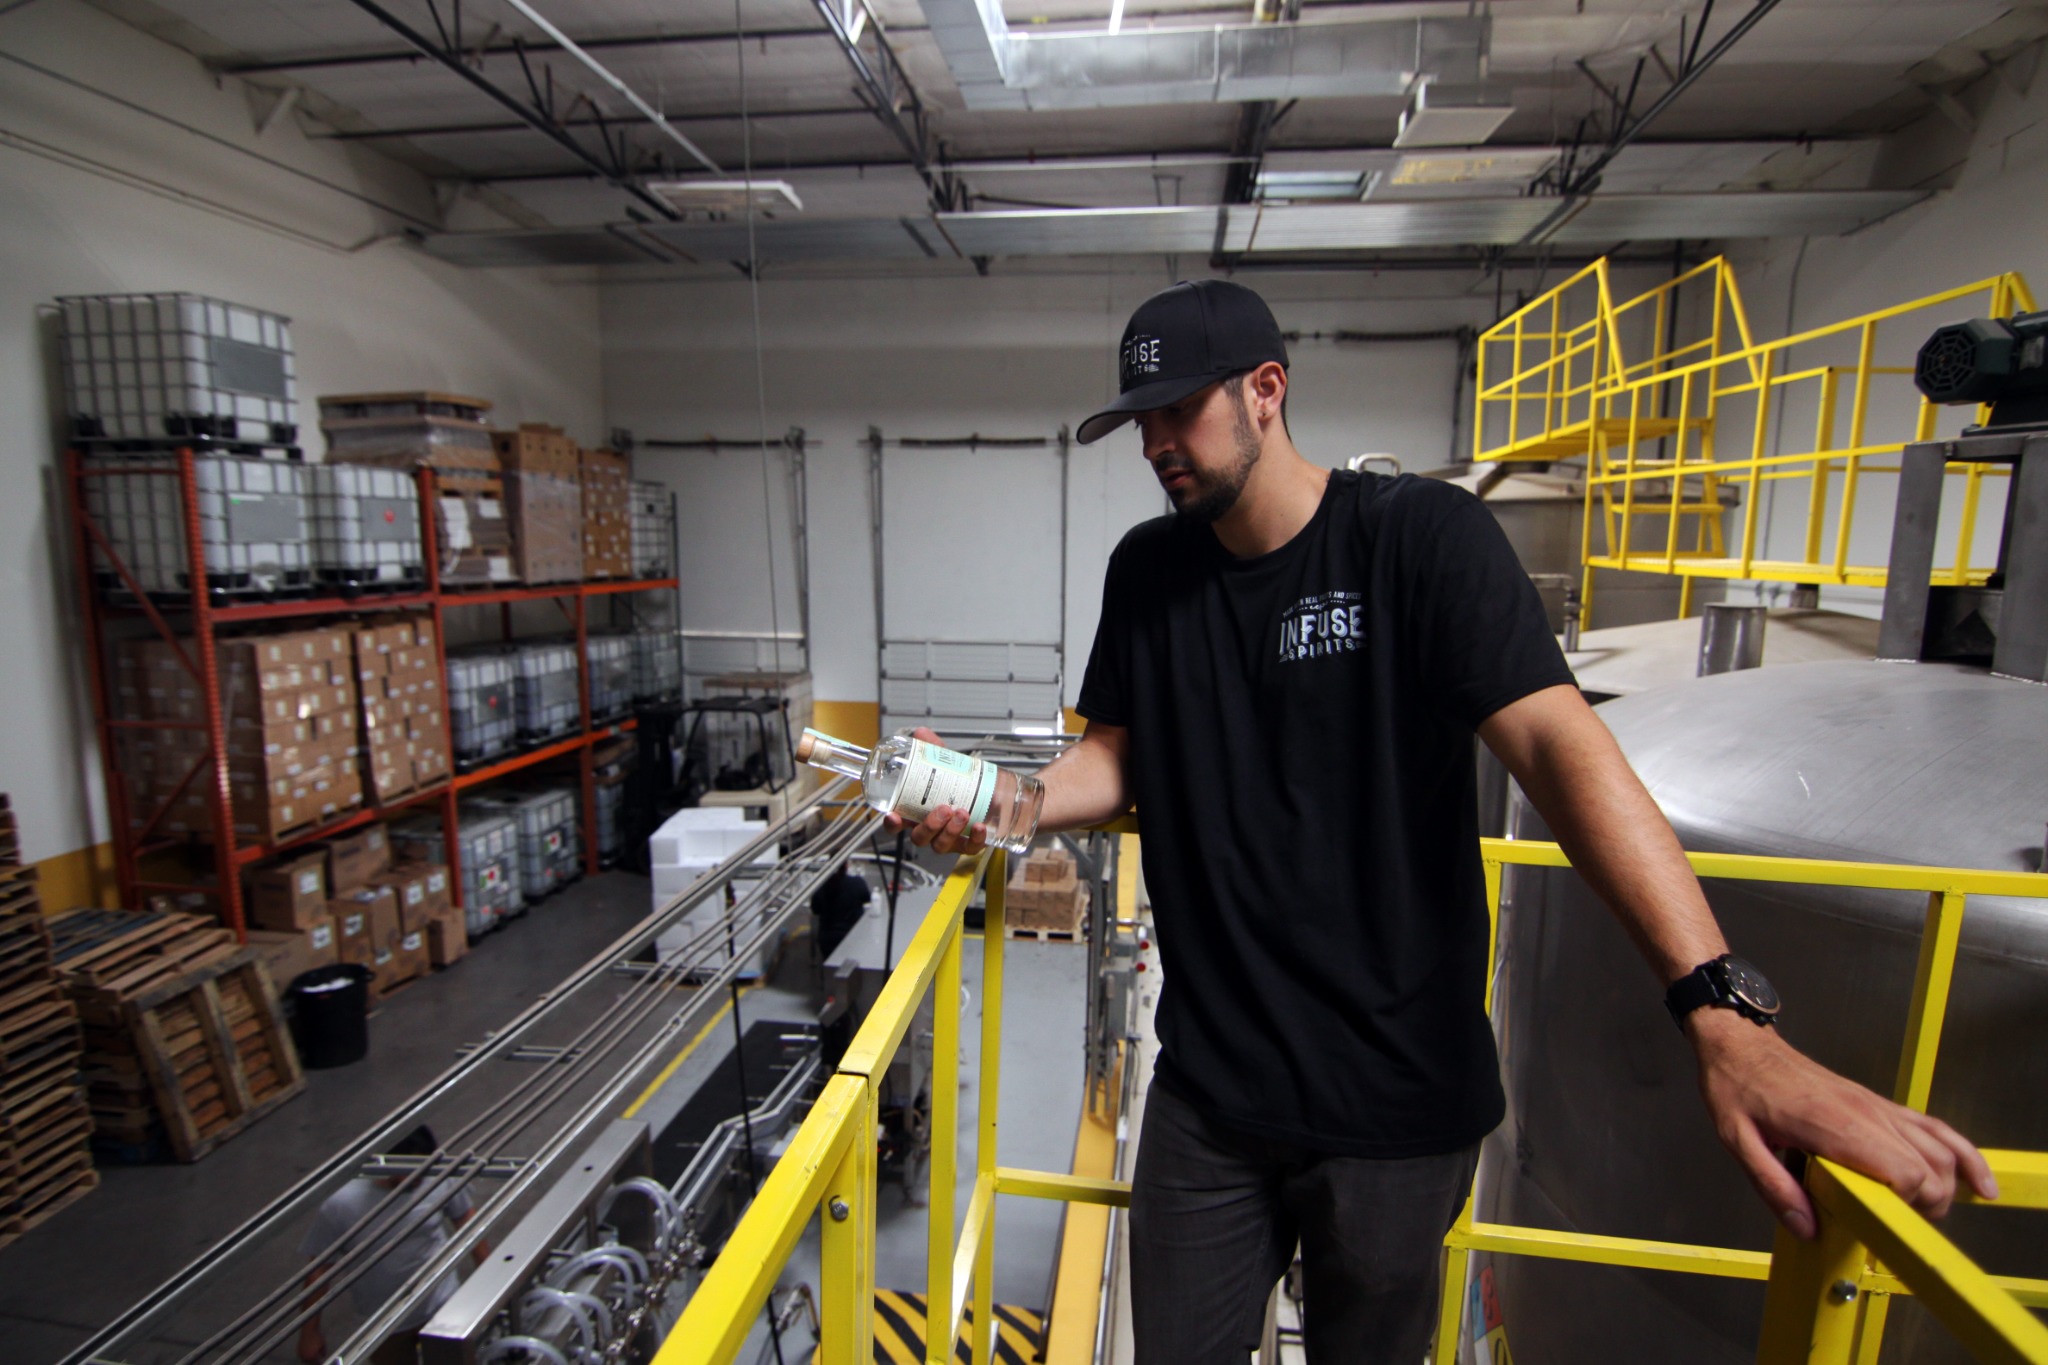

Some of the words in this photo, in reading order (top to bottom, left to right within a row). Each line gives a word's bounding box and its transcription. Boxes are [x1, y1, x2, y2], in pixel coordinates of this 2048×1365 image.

[1305, 596, 1319, 605] REAL
[1333, 591, 1345, 599] AND
[1279, 605, 1366, 656] INFUSE
[1288, 638, 1355, 660] SPIRITS
